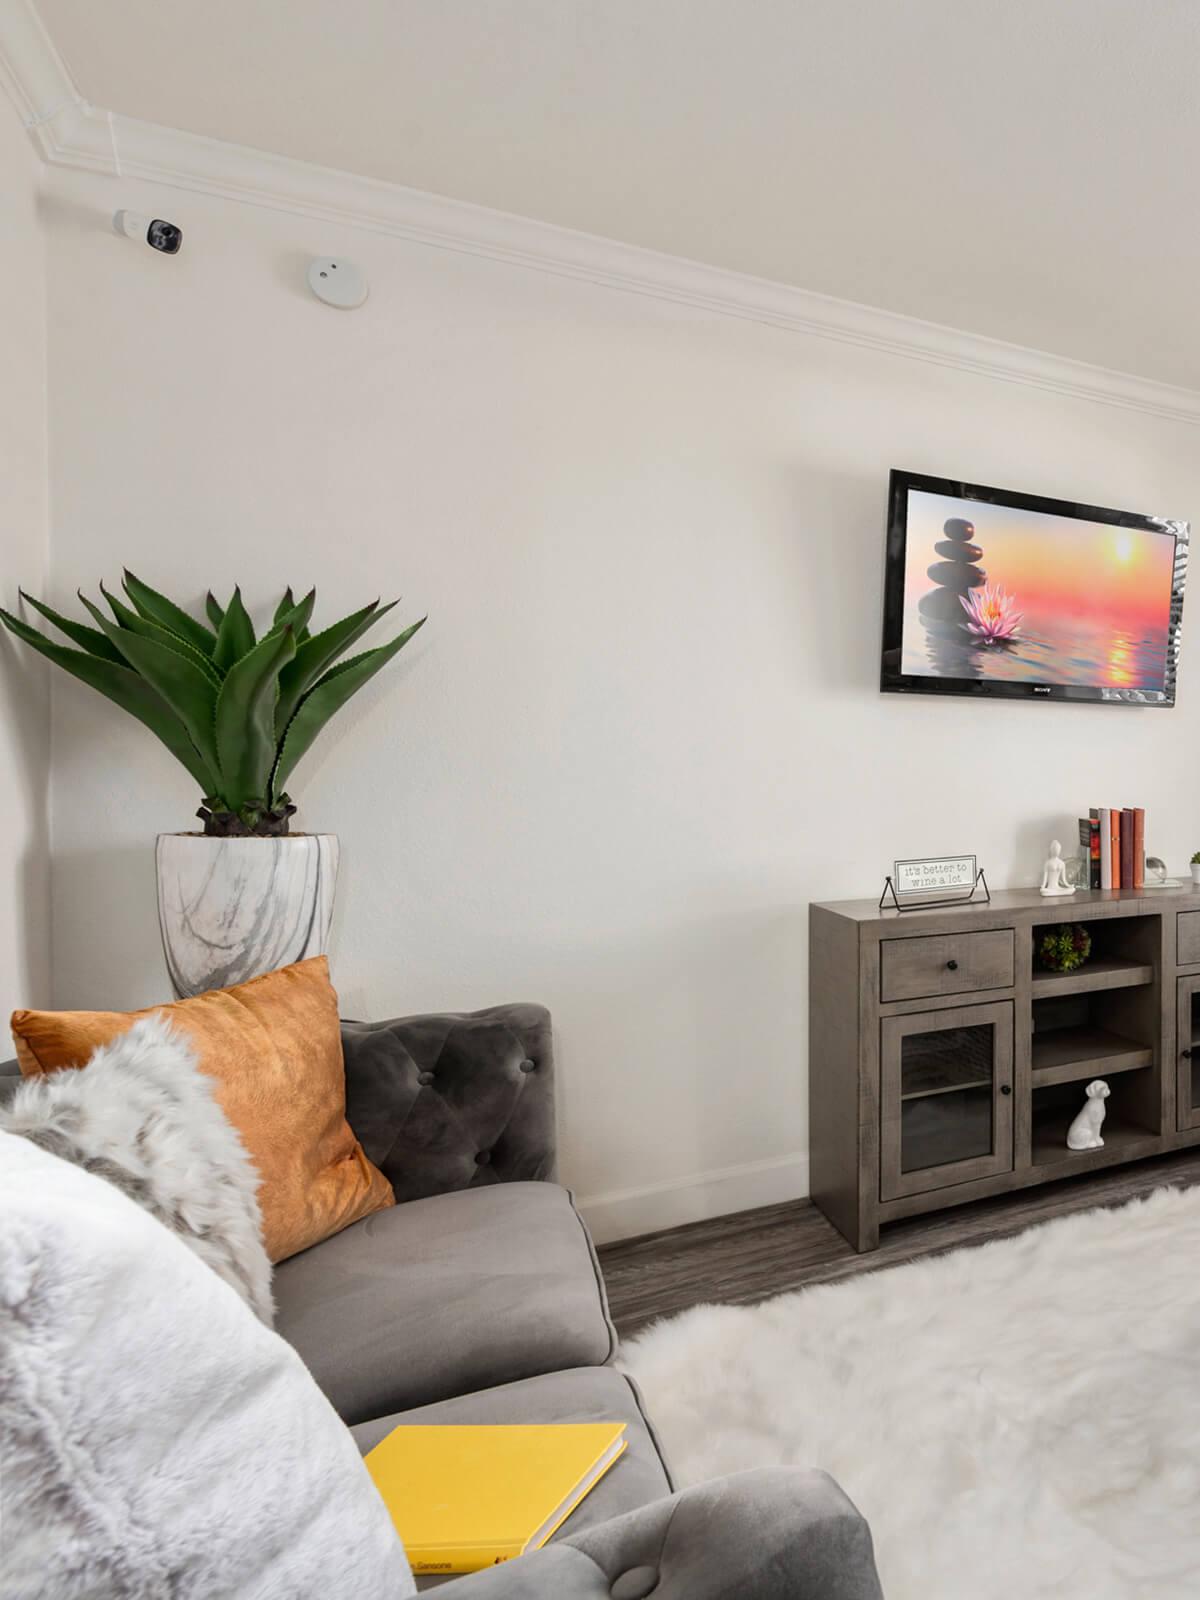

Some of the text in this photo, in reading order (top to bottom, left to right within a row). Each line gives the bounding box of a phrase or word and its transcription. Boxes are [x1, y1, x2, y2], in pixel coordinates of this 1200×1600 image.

[905, 863, 967, 876] it's better to
[911, 874, 962, 887] wine a lot
